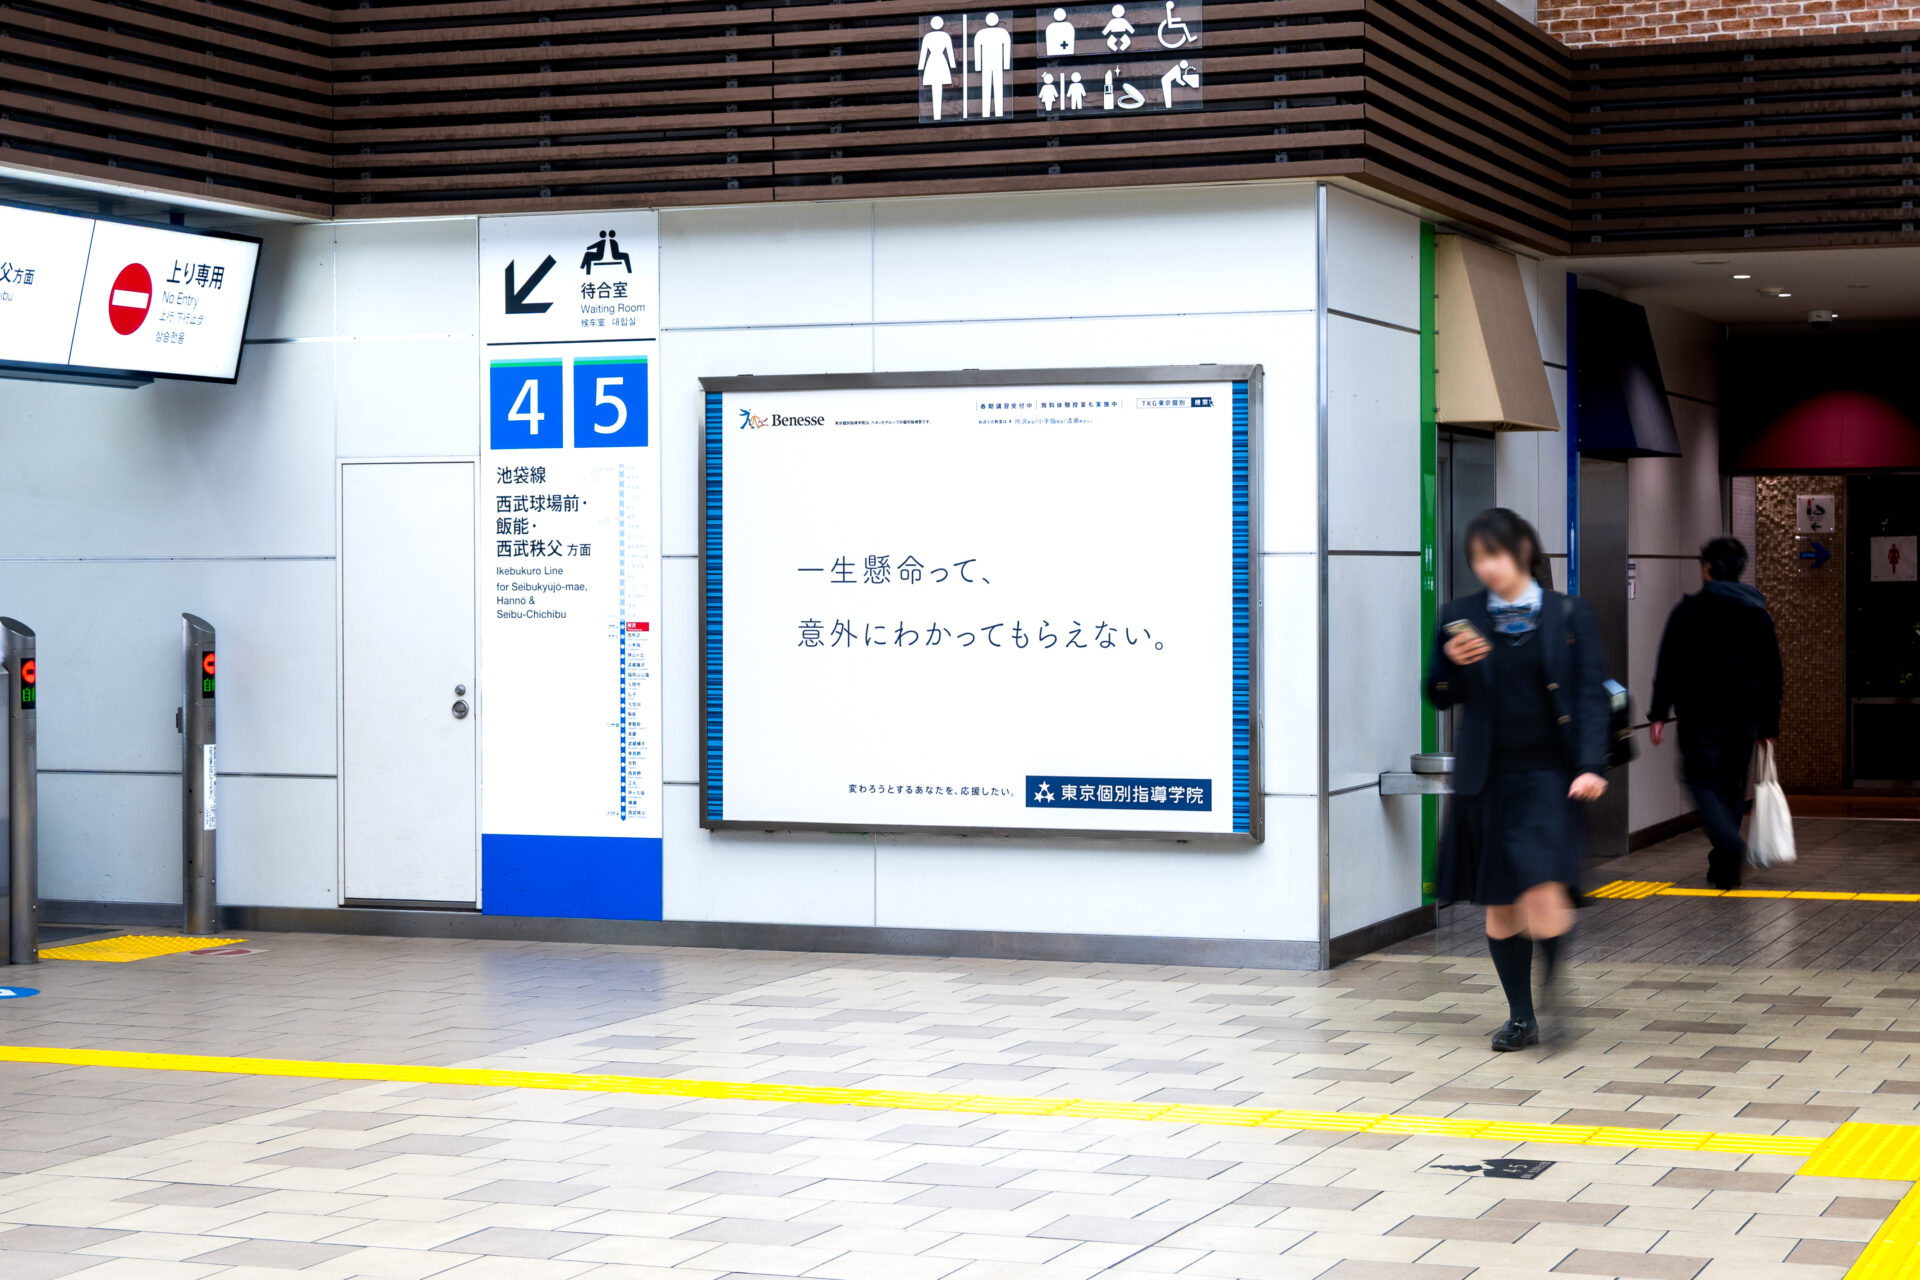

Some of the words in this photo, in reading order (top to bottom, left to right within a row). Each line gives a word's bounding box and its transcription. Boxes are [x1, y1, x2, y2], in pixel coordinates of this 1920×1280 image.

[166, 259, 225, 290] 上り専用
[581, 281, 628, 299] 待合室
[162, 291, 175, 304] No
[177, 292, 200, 309] Entry
[580, 303, 615, 316] Waiting
[618, 303, 645, 312] Room
[612, 317, 636, 326] 대합실
[156, 331, 184, 344] 상승전용
[508, 379, 544, 435] 4
[594, 377, 627, 434] 5
[772, 414, 824, 426] Benesse
[497, 466, 546, 484] 池袋線
[496, 539, 562, 557] 西武秩父
[567, 544, 591, 556] 方面
[496, 566, 542, 576] Ikebukuro
[545, 566, 563, 575] Line
[798, 555, 989, 584] 一生懸命って、
[496, 581, 510, 592] for
[529, 596, 535, 605] &
[497, 610, 566, 618] Seibu-Chichibu
[798, 618, 1163, 650] 意外にわかってもらえない。
[849, 784, 1013, 796] 変わろうとするあなたを、応援したい。
[1062, 784, 1203, 803] 東京個別指導学院
